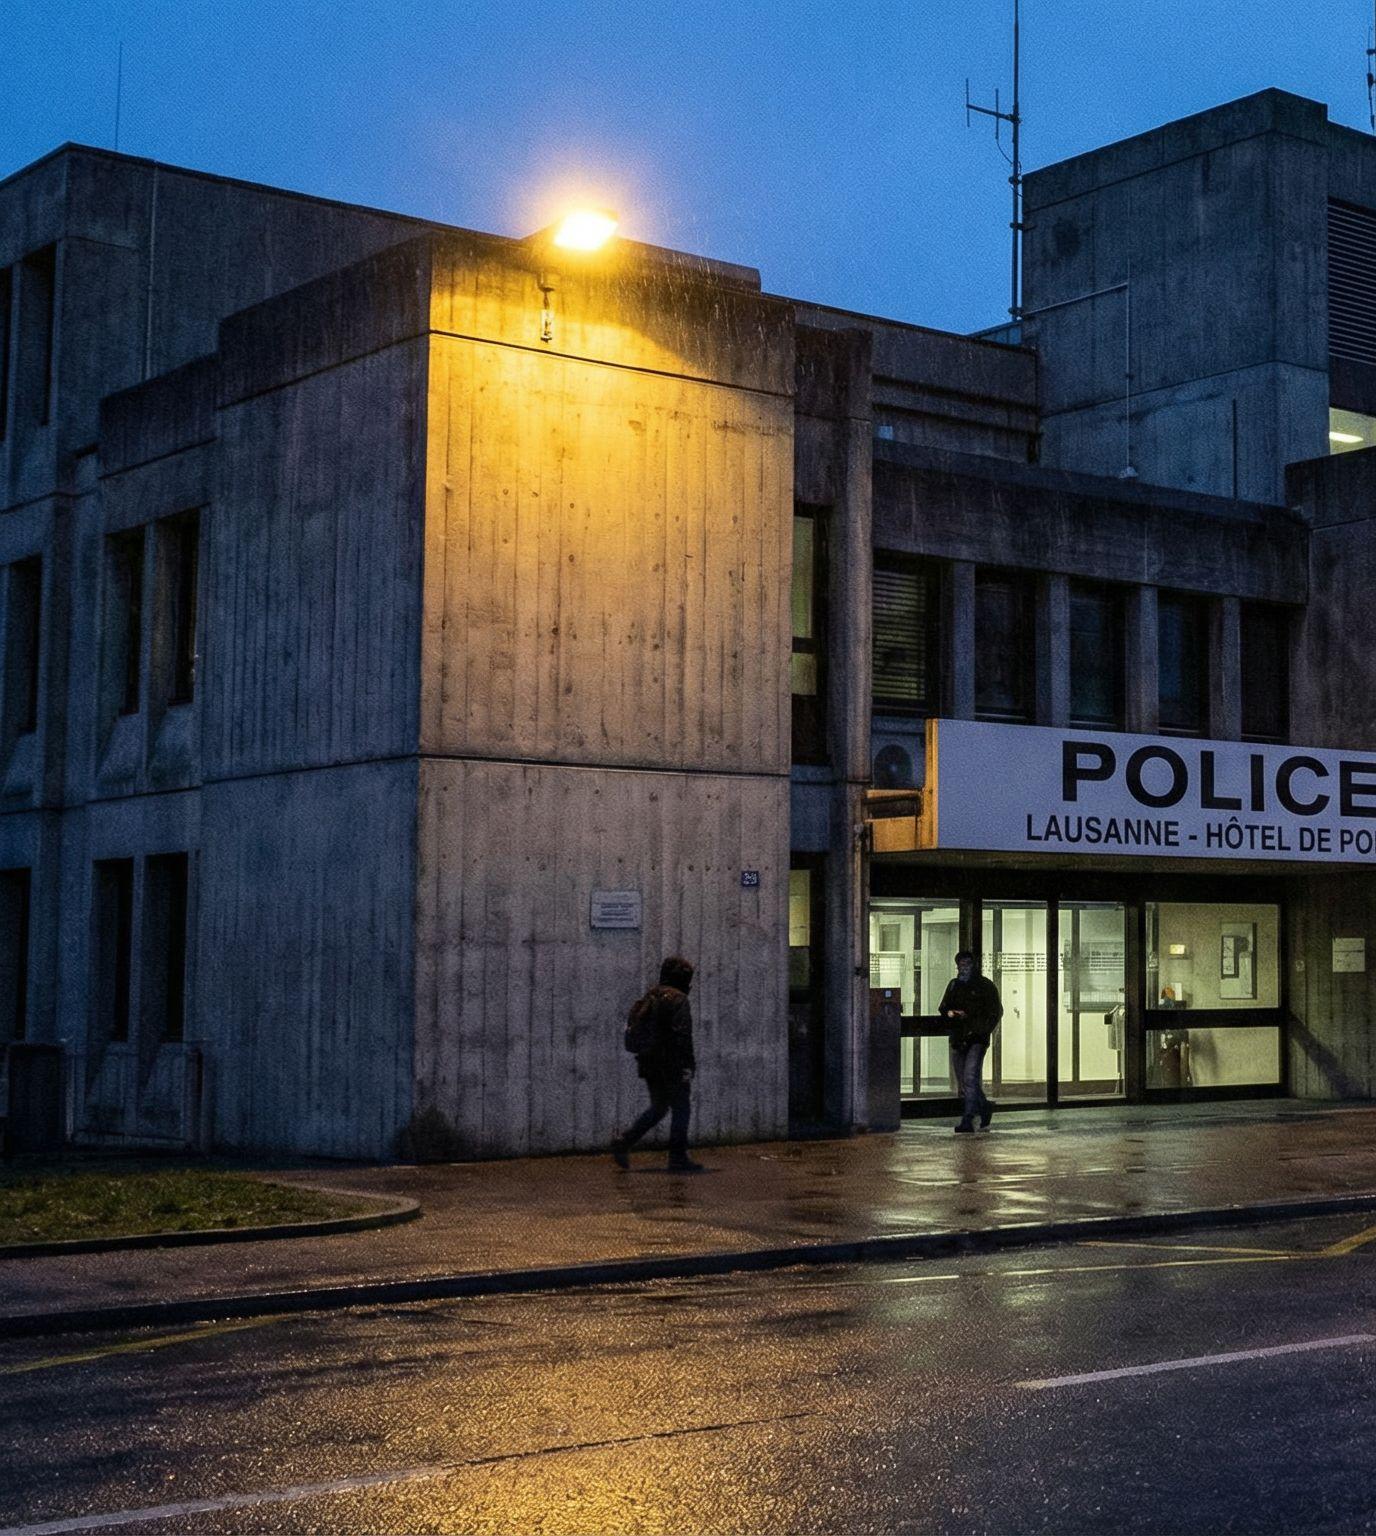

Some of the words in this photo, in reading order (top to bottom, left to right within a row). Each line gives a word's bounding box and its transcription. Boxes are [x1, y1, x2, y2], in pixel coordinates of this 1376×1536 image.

[1026, 814, 1180, 847] LAUSANNE
[1206, 816, 1291, 852] HÔTEL
[1299, 827, 1332, 854] DE
